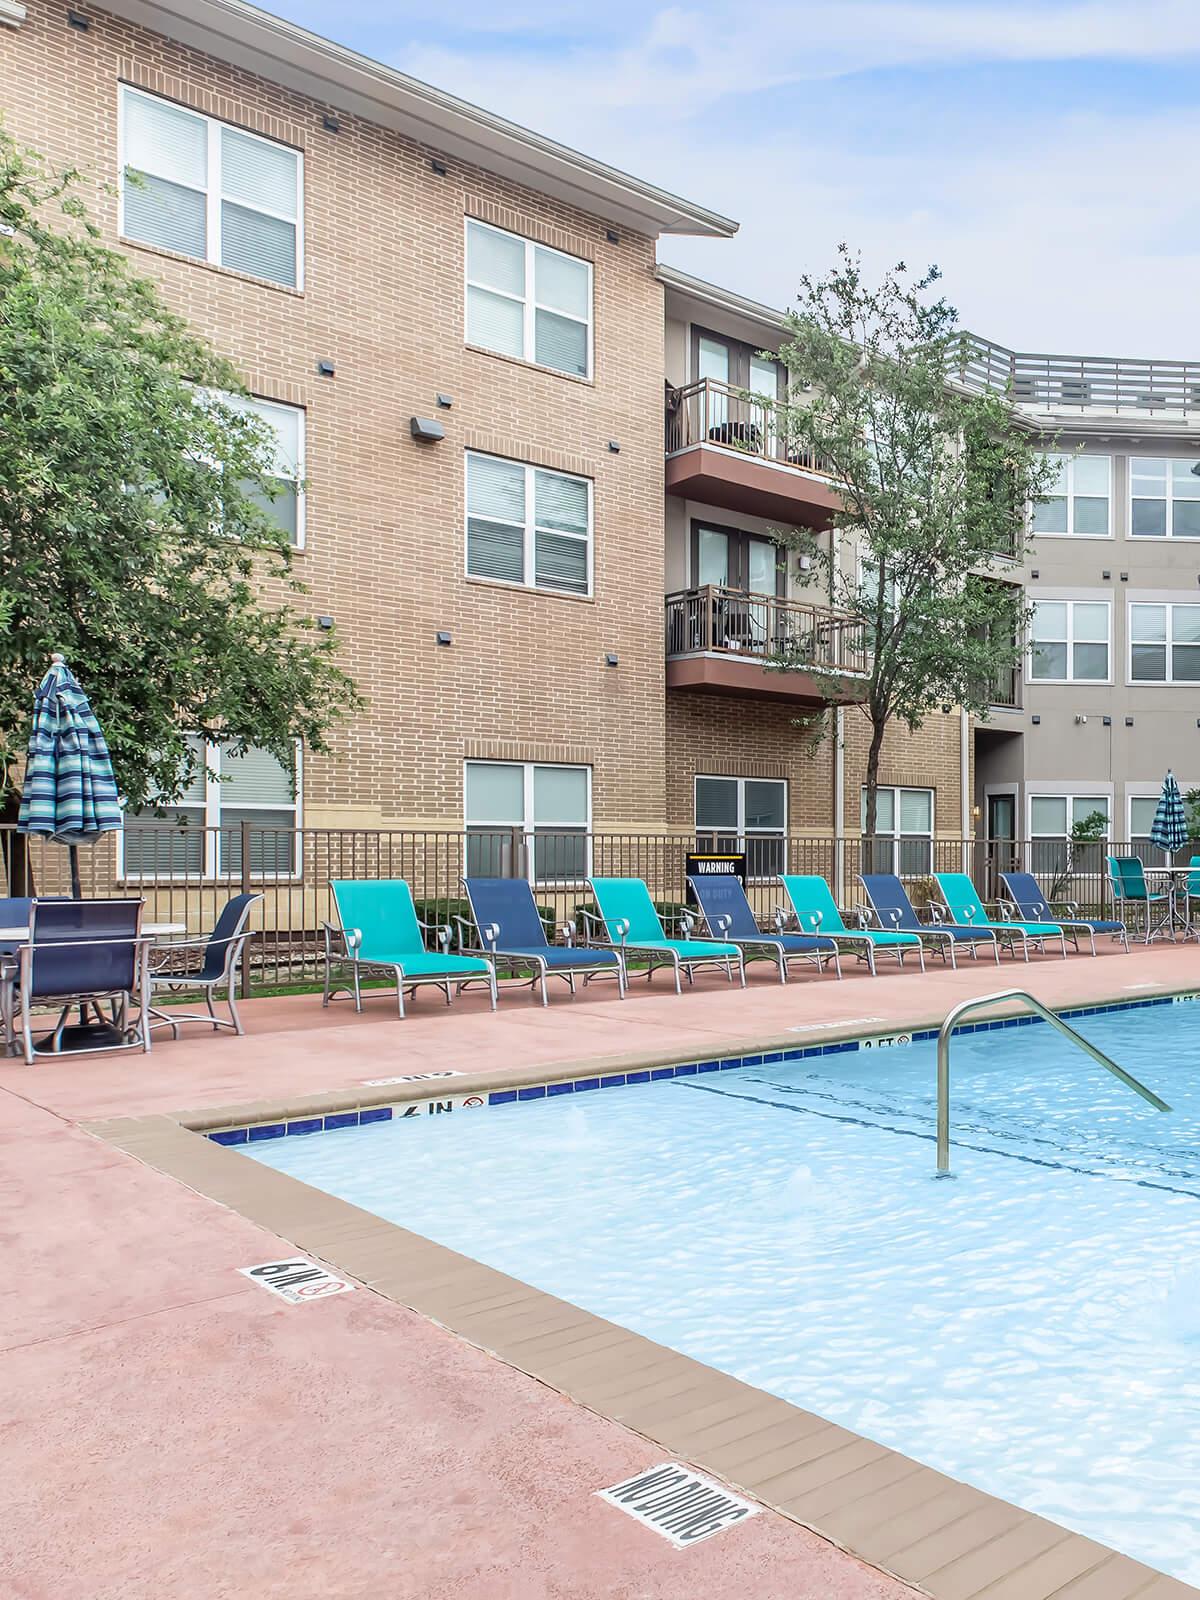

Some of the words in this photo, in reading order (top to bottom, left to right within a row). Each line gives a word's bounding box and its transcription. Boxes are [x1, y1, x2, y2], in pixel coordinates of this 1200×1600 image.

[697, 861, 735, 874] WARNING
[250, 1263, 308, 1276] 6
[607, 1466, 689, 1503] NO
[632, 1481, 739, 1540] DIVING
